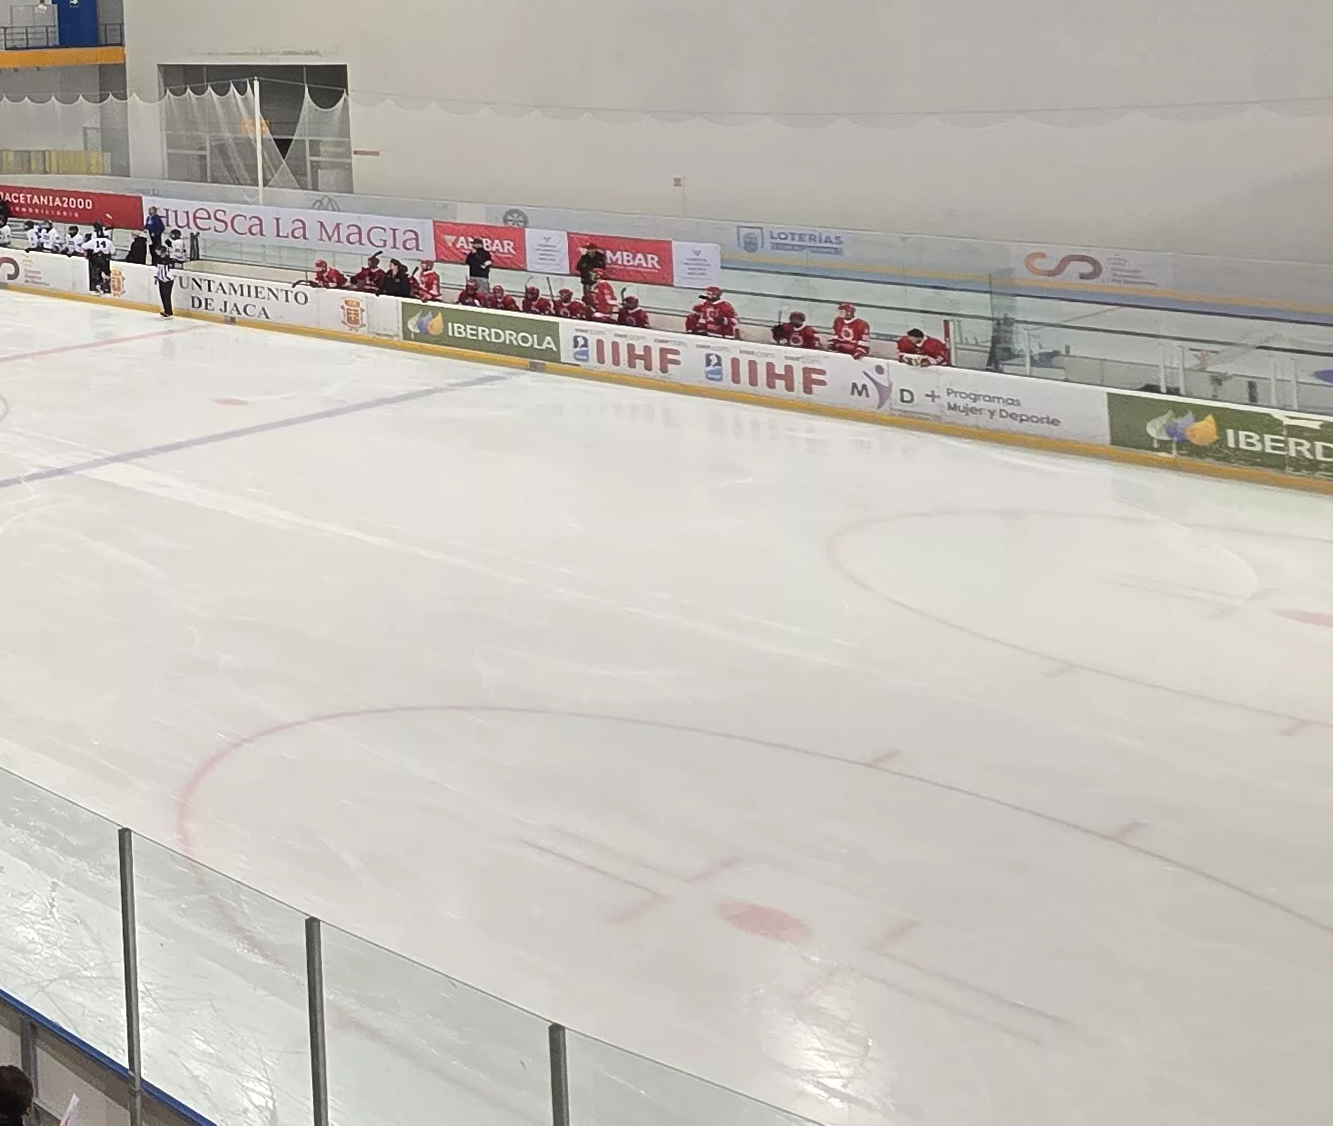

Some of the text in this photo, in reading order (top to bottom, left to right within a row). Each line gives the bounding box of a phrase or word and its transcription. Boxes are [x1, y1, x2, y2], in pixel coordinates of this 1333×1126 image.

[0, 191, 93, 210] JACETANIA2000
[96, 240, 107, 249] 14
[605, 249, 661, 269] MBAR
[190, 295, 271, 320] DE JACA
[447, 322, 558, 352] IBERDROLA
[595, 338, 682, 374] IIHF
[730, 356, 828, 395] IIHF
[946, 387, 1022, 407] Programas
[947, 402, 1062, 427] Mujer y Deporte
[1226, 428, 1333, 462] IBERD
